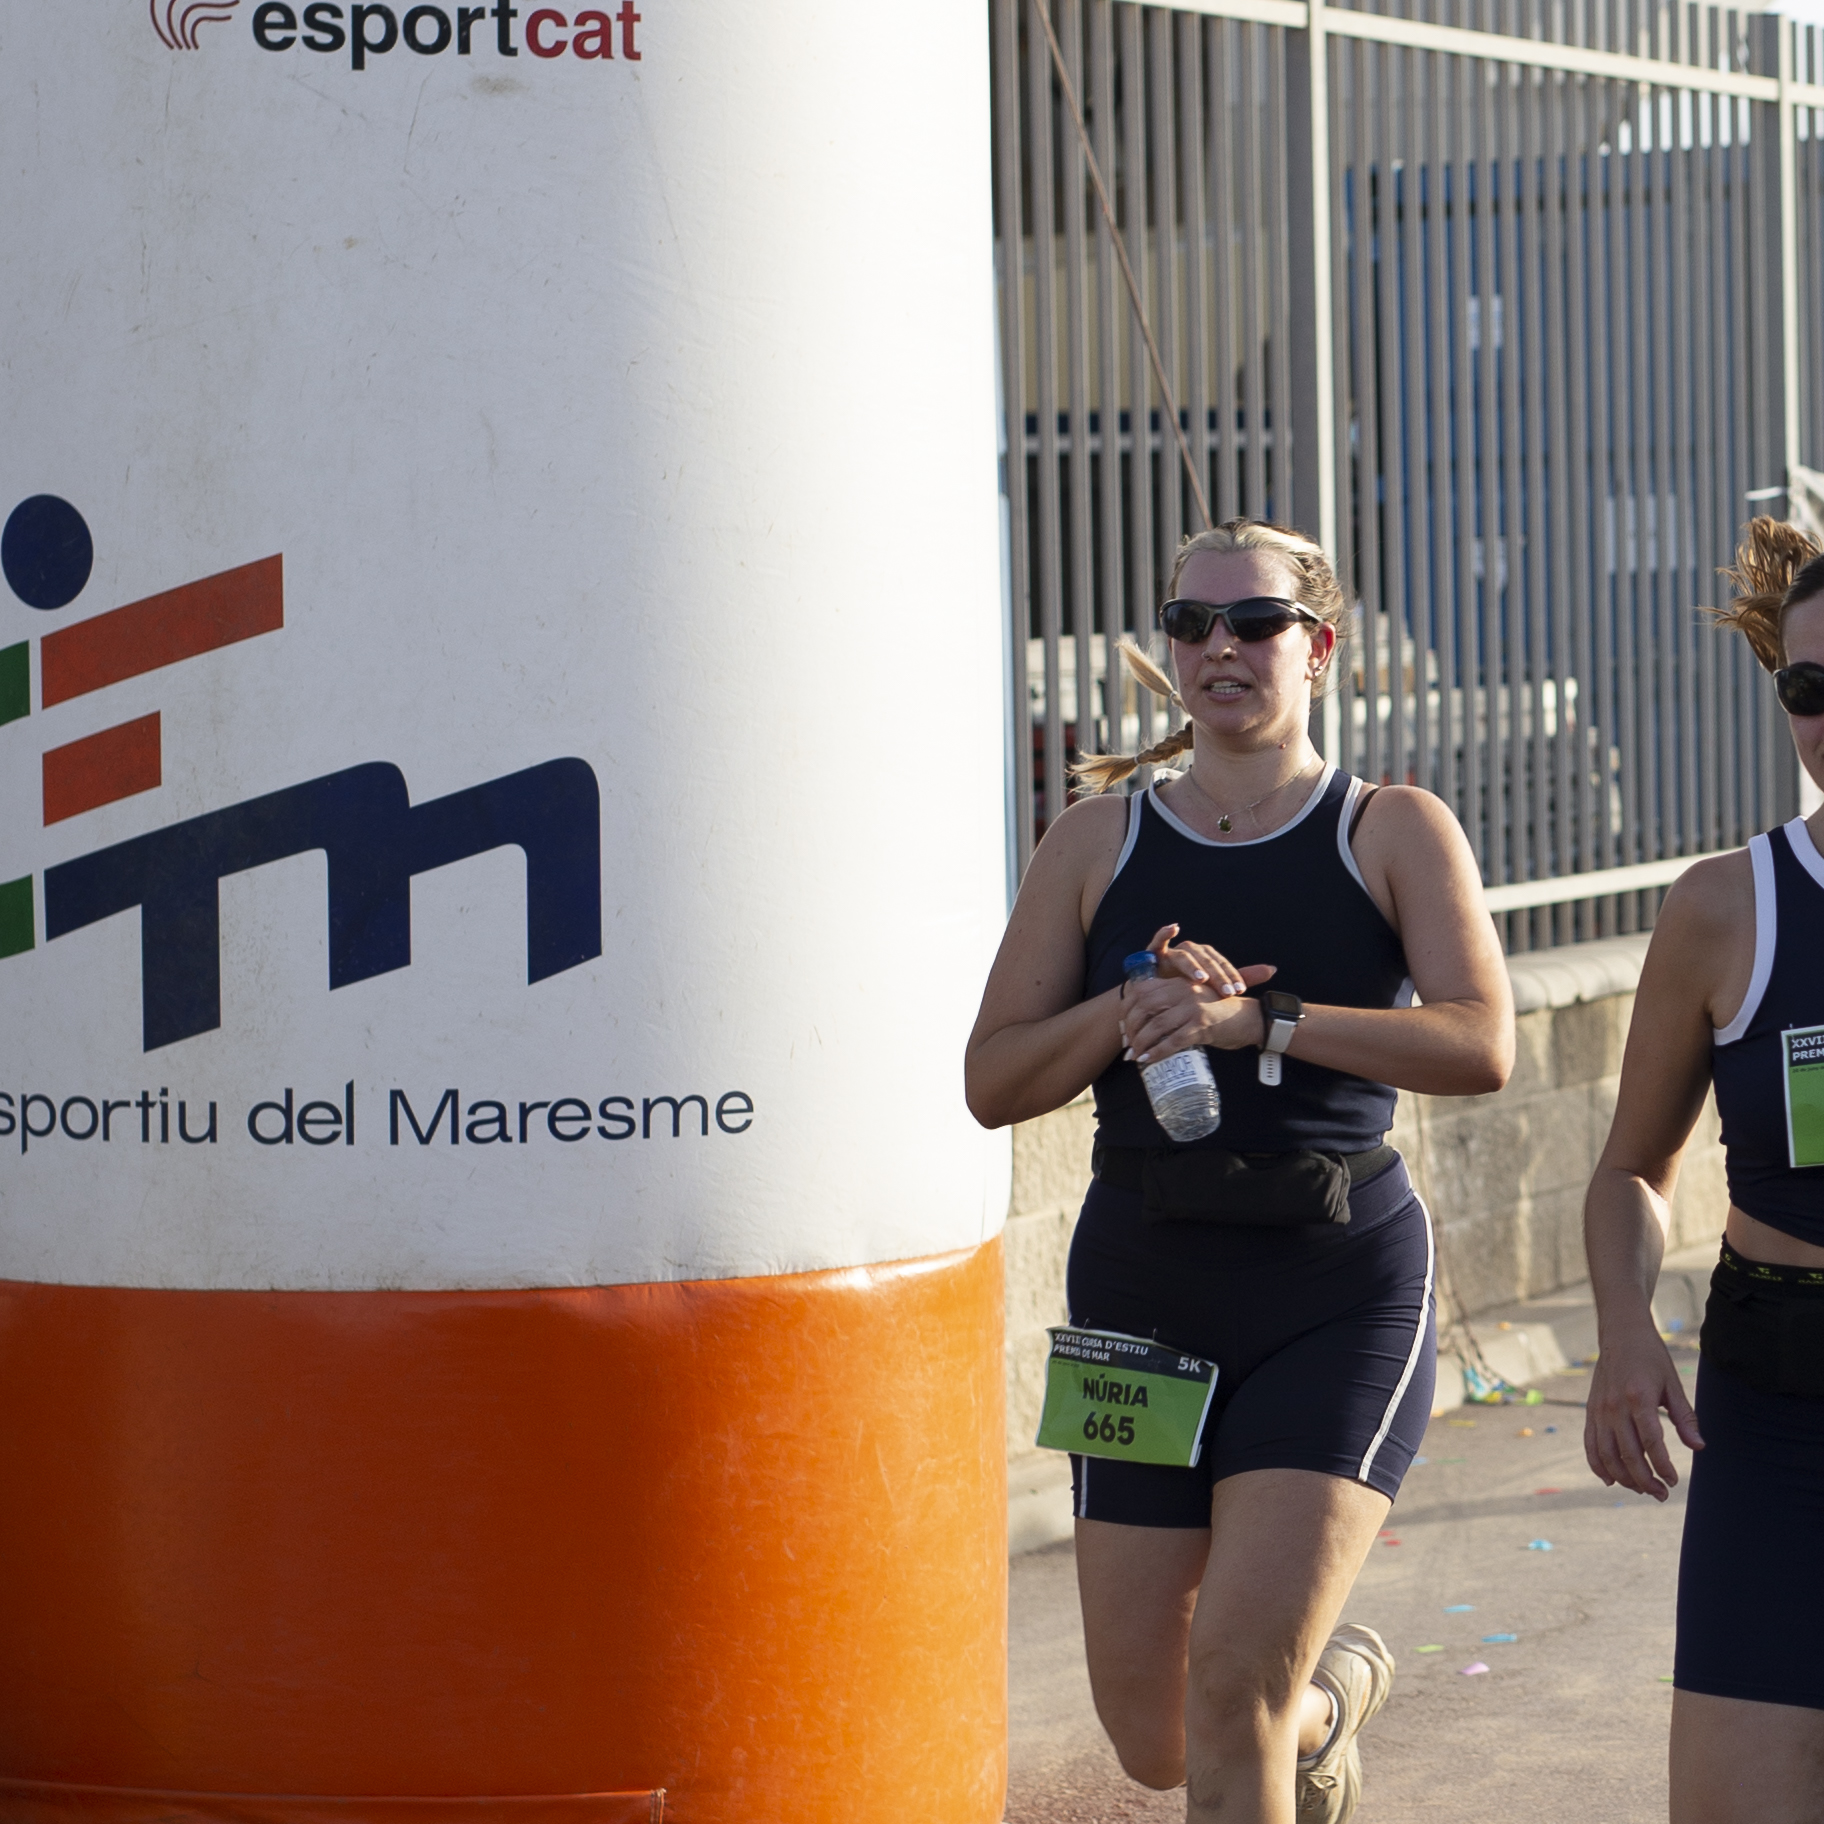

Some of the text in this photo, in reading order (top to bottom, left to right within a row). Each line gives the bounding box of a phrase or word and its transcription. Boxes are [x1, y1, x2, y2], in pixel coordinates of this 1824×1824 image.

[247, 1079, 355, 1146] del
[388, 1088, 755, 1146] Maresme
[1091, 1349, 1110, 1362] MAR
[1177, 1356, 1201, 1374] 5K
[1083, 1373, 1149, 1409] NÚRIA
[1083, 1411, 1135, 1446] 665
